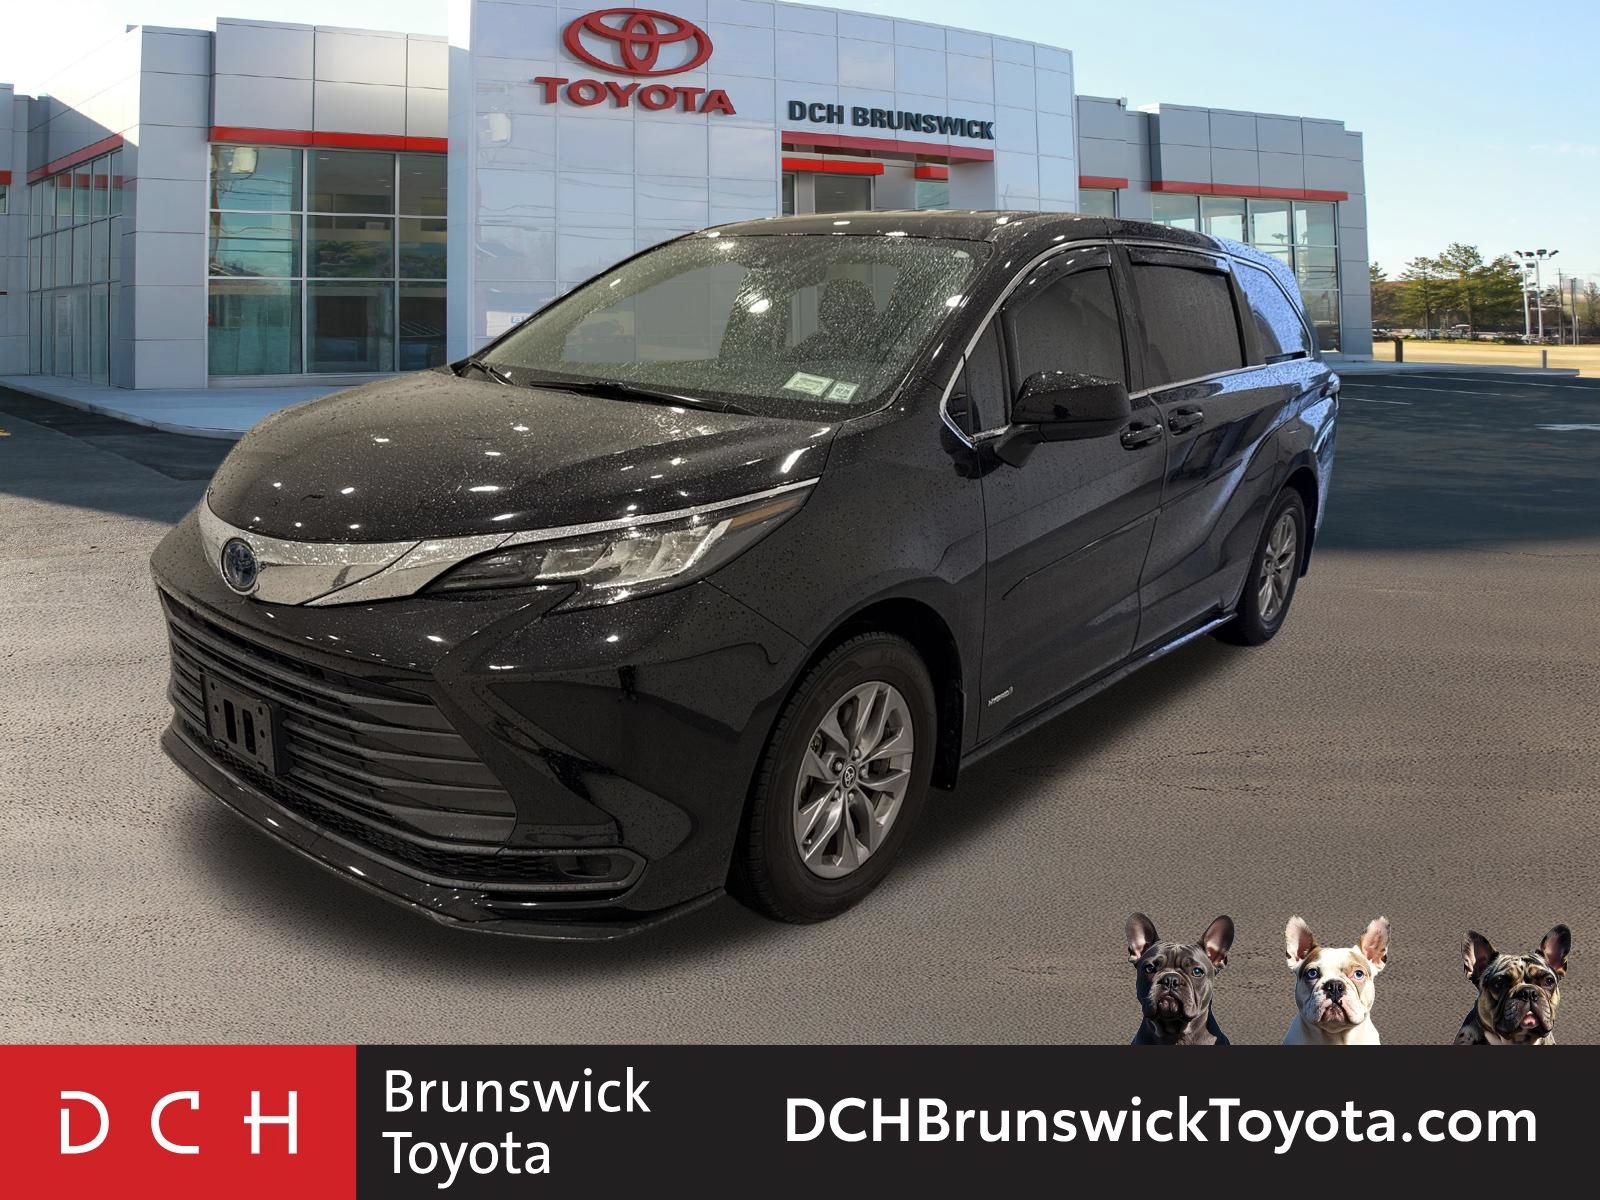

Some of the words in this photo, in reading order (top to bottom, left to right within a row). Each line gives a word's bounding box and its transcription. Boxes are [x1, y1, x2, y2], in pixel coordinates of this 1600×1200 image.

[534, 76, 736, 115] TOYOTA
[787, 99, 846, 126] DCH
[851, 105, 995, 141] BRUNSWICK
